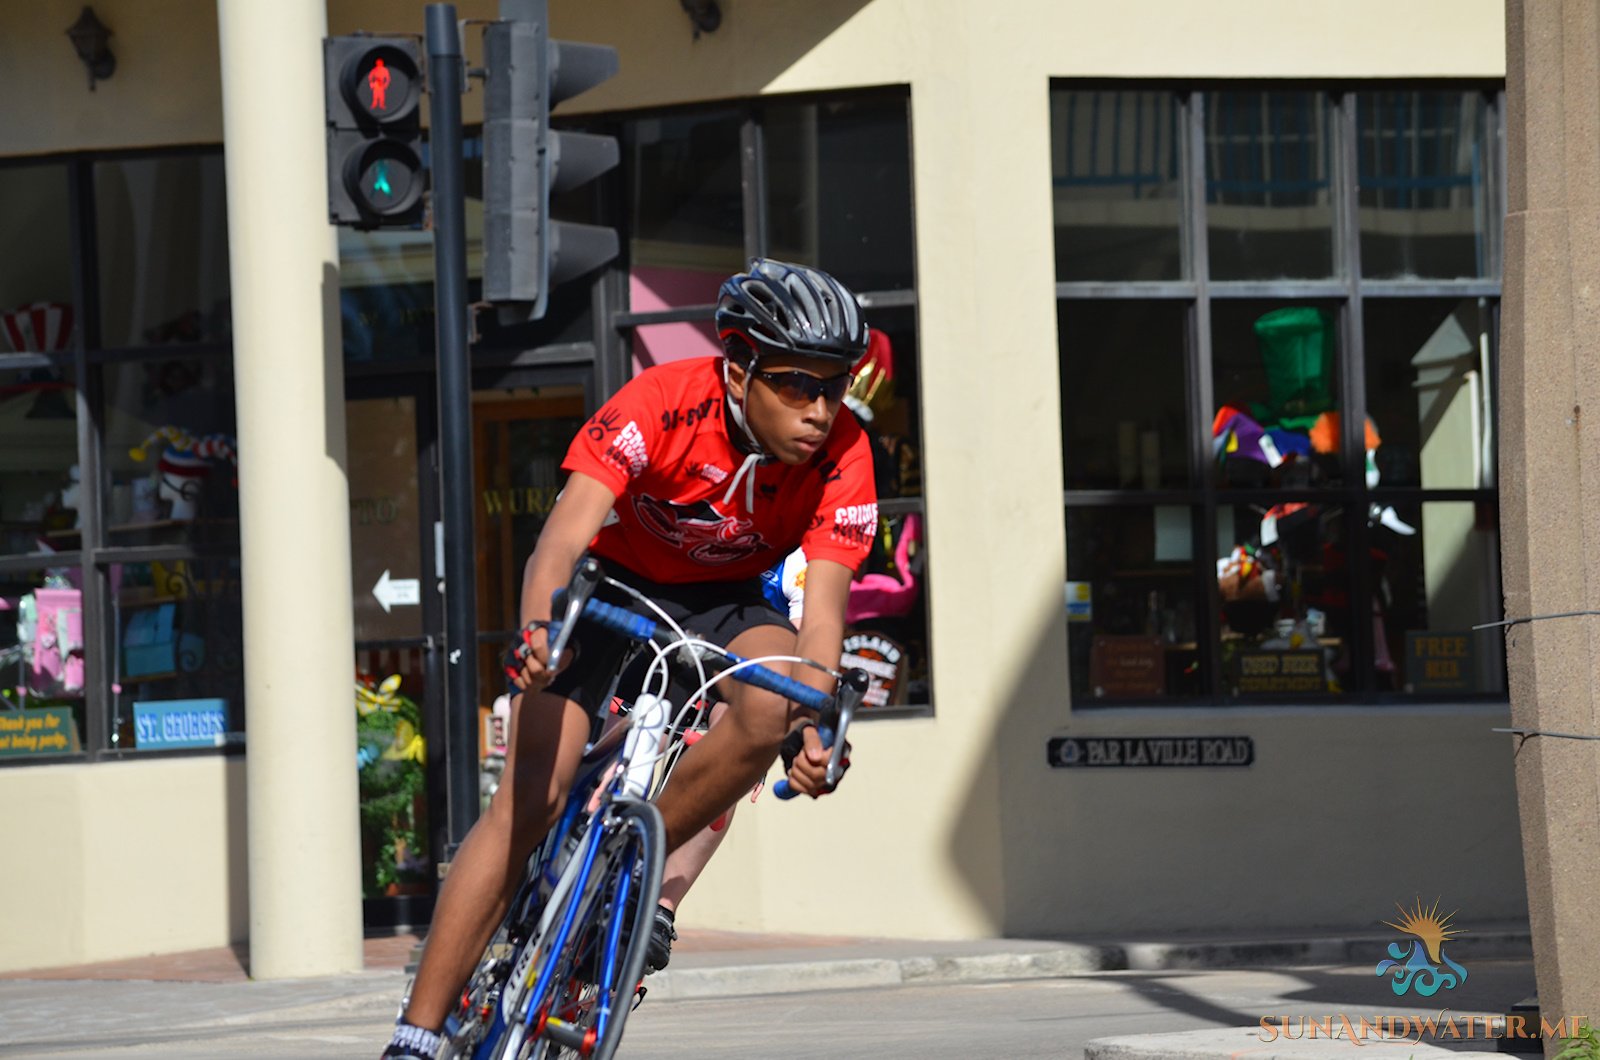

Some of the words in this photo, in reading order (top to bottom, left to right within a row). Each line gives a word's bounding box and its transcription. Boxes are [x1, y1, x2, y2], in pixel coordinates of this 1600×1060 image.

[1086, 740, 1121, 764] PAR
[1123, 740, 1149, 764] LA
[1148, 740, 1198, 764] VILLE
[1201, 740, 1248, 764] ROAD
